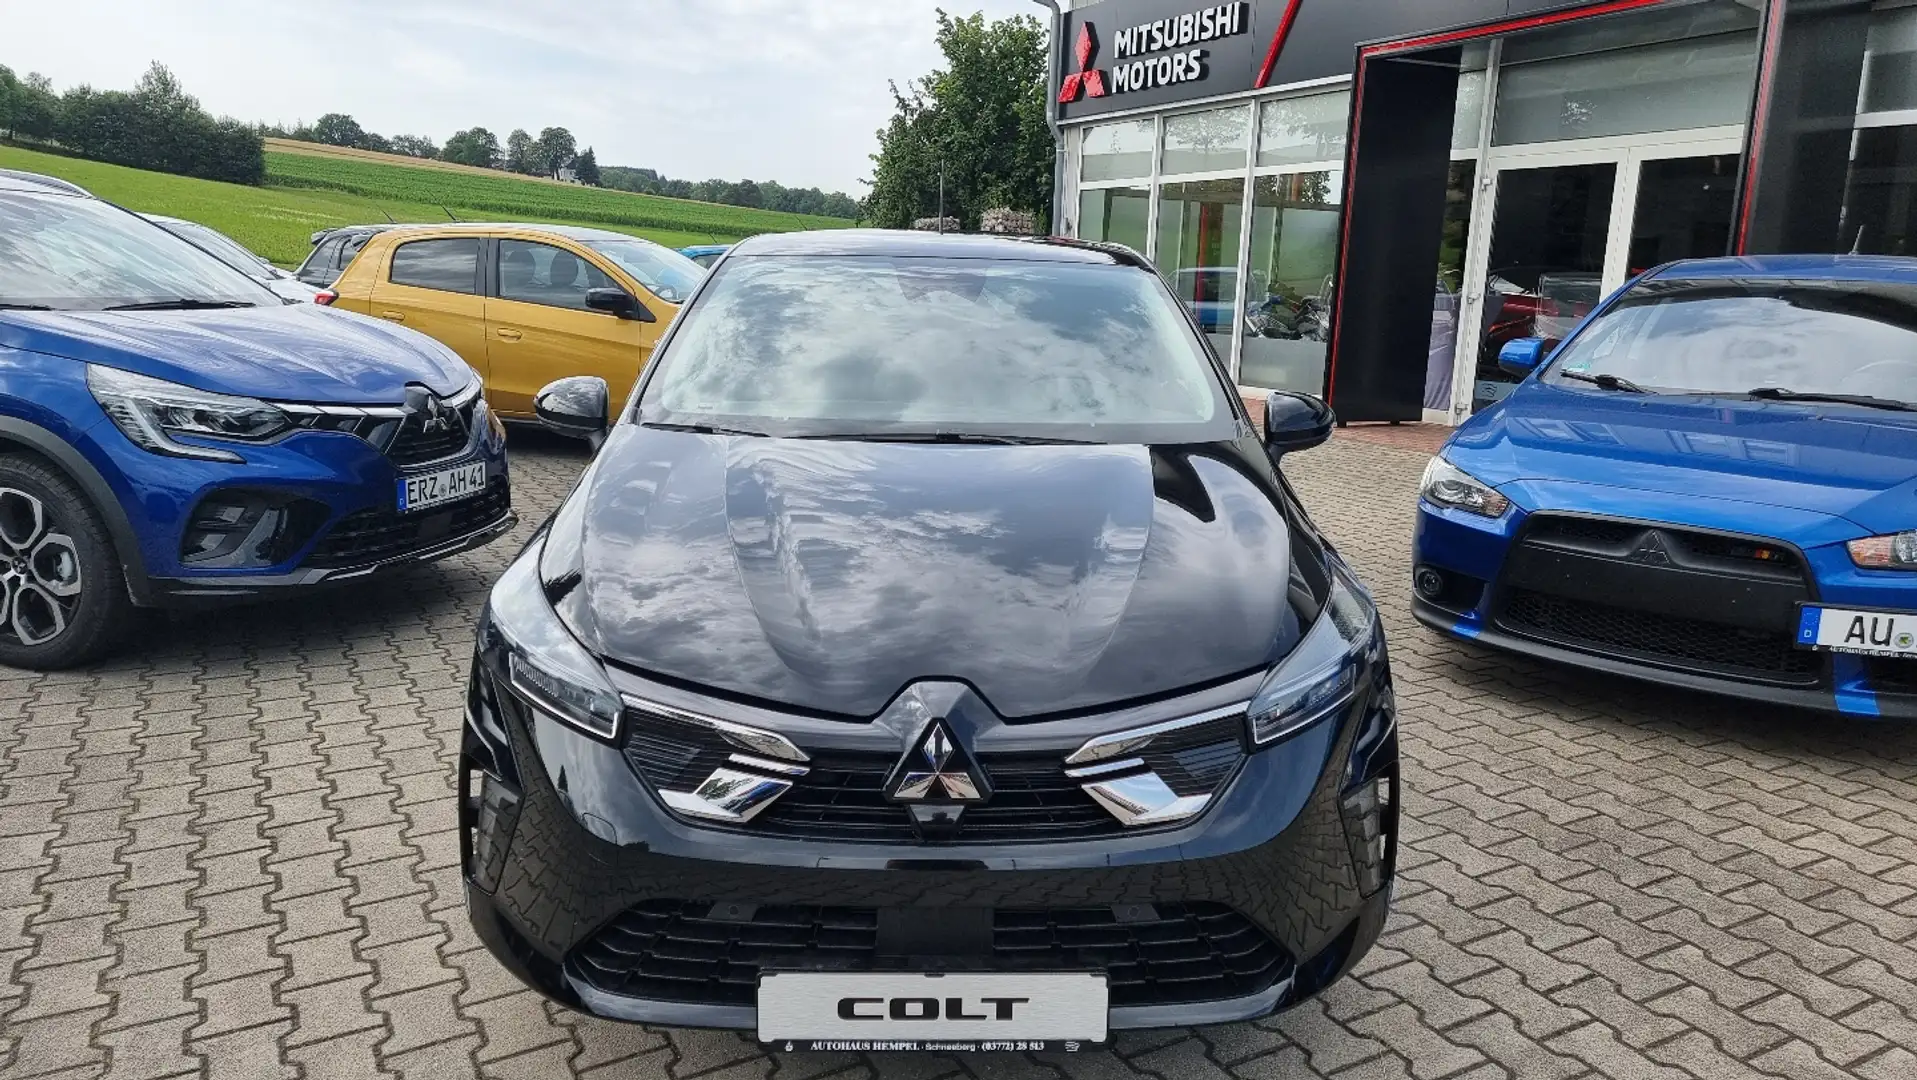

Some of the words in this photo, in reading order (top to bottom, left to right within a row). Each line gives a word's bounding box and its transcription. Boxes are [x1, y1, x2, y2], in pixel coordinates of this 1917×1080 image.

[1114, 1, 1241, 58] MITSUBISHI
[1112, 49, 1202, 94] MOTORS
[407, 476, 438, 504] ERZ
[448, 470, 467, 495] AH
[469, 465, 485, 488] 41
[1804, 629, 1812, 638] D
[1844, 615, 1894, 646] AU
[837, 997, 1030, 1021] COLT
[810, 1041, 871, 1051] AUTOHAUS
[872, 1041, 920, 1051] HEMPEL
[925, 1042, 976, 1052] Schneeberg
[981, 1041, 1014, 1052] (03772)
[1016, 1041, 1027, 1051] 28
